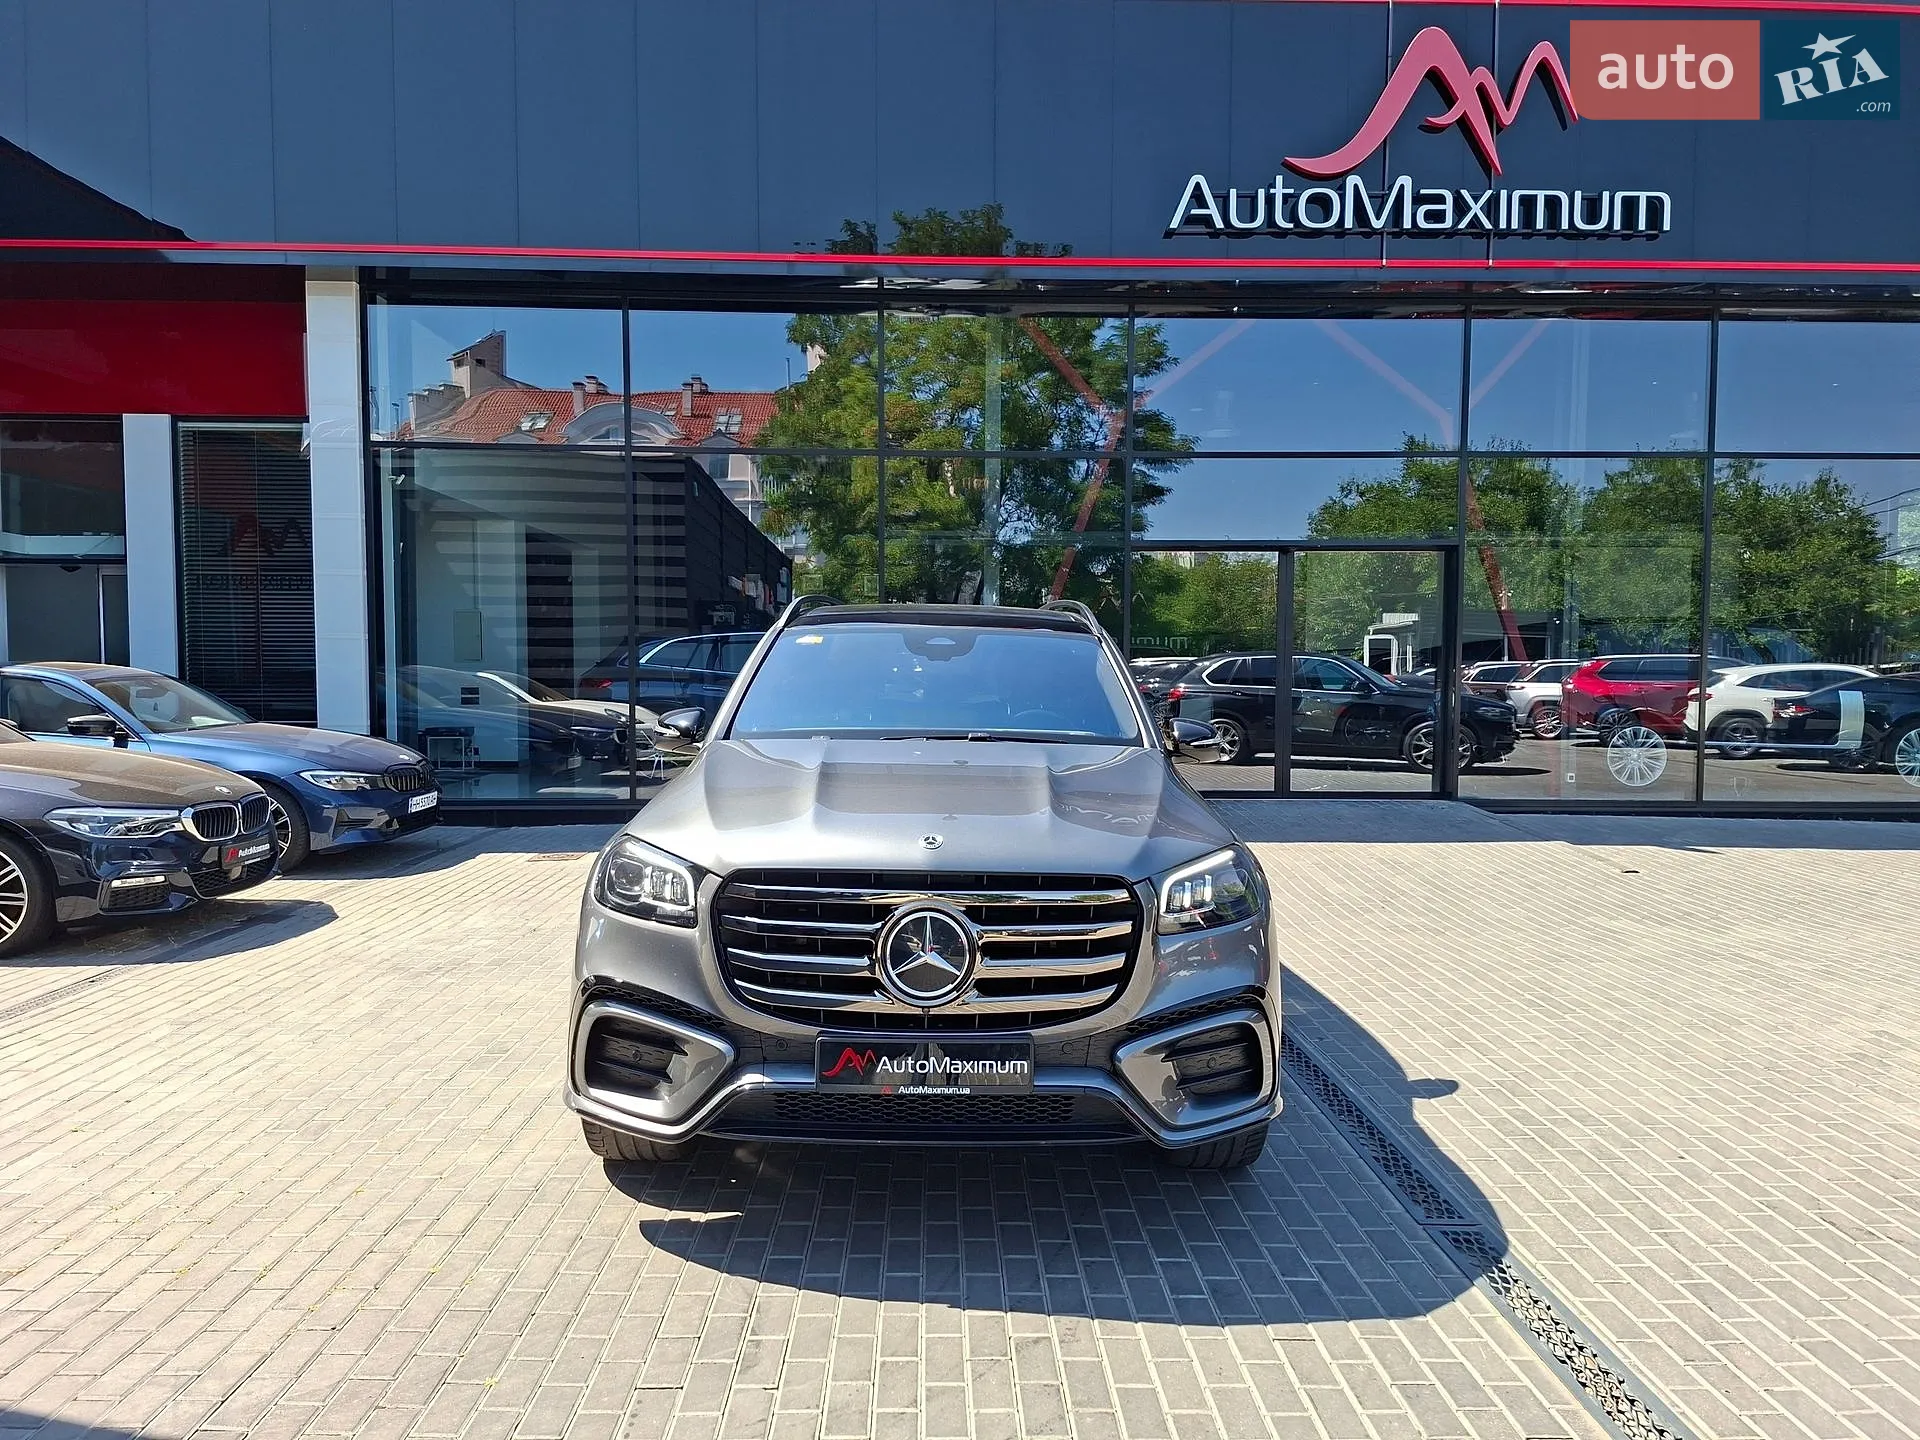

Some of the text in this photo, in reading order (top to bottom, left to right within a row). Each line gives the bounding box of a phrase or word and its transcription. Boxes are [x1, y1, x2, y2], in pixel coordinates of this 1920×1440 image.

[1169, 174, 1672, 231] AutoMaximum
[876, 1056, 1028, 1074] AutoMaximum
[898, 1085, 971, 1095] AutoMaximum.ua
